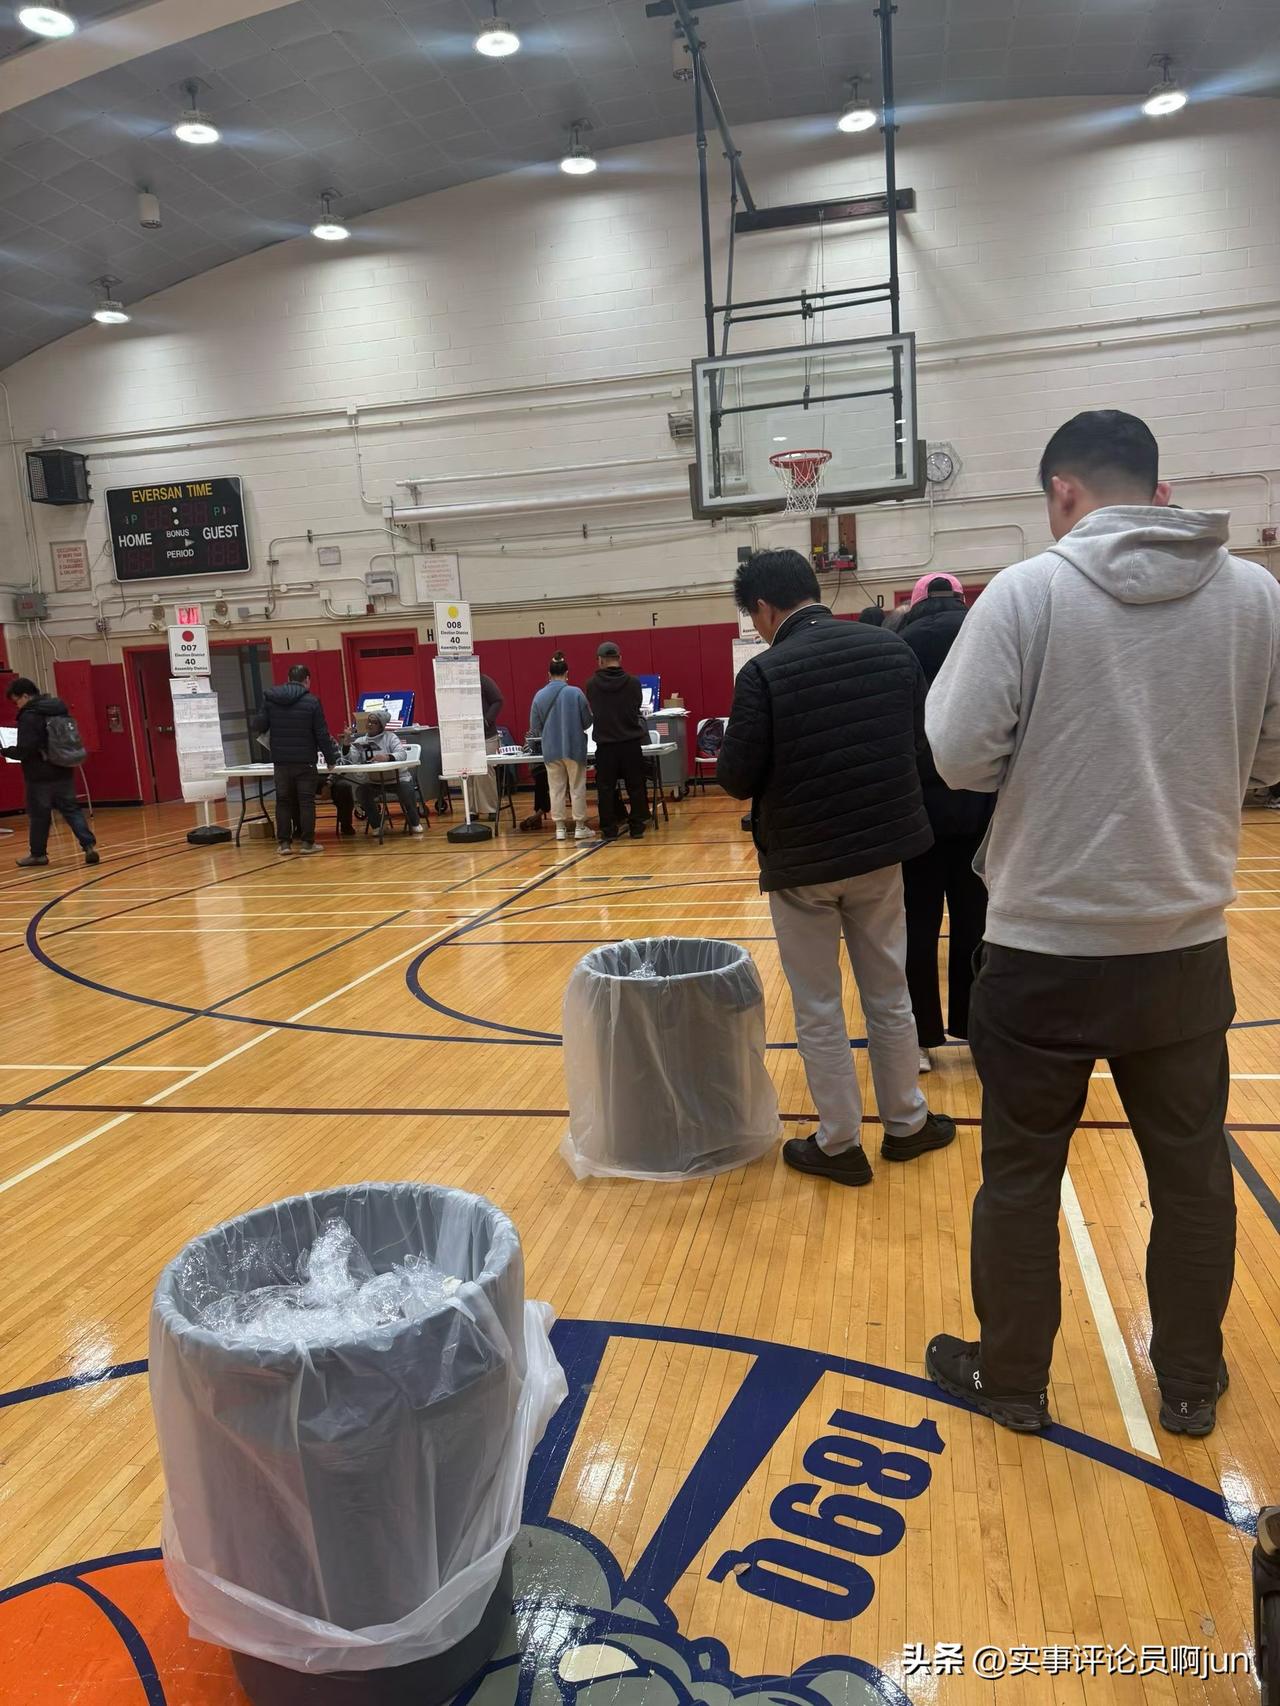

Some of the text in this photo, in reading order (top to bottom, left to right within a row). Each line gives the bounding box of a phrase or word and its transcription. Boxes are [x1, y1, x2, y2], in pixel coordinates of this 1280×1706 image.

[132, 483, 213, 503] EVERSAN TIME
[166, 529, 190, 538] BONUS
[202, 524, 239, 540] GUEST
[119, 533, 152, 547] HOME
[166, 549, 194, 559] PERIOD
[652, 613, 658, 626] F
[538, 622, 545, 634] G
[427, 629, 434, 641] H
